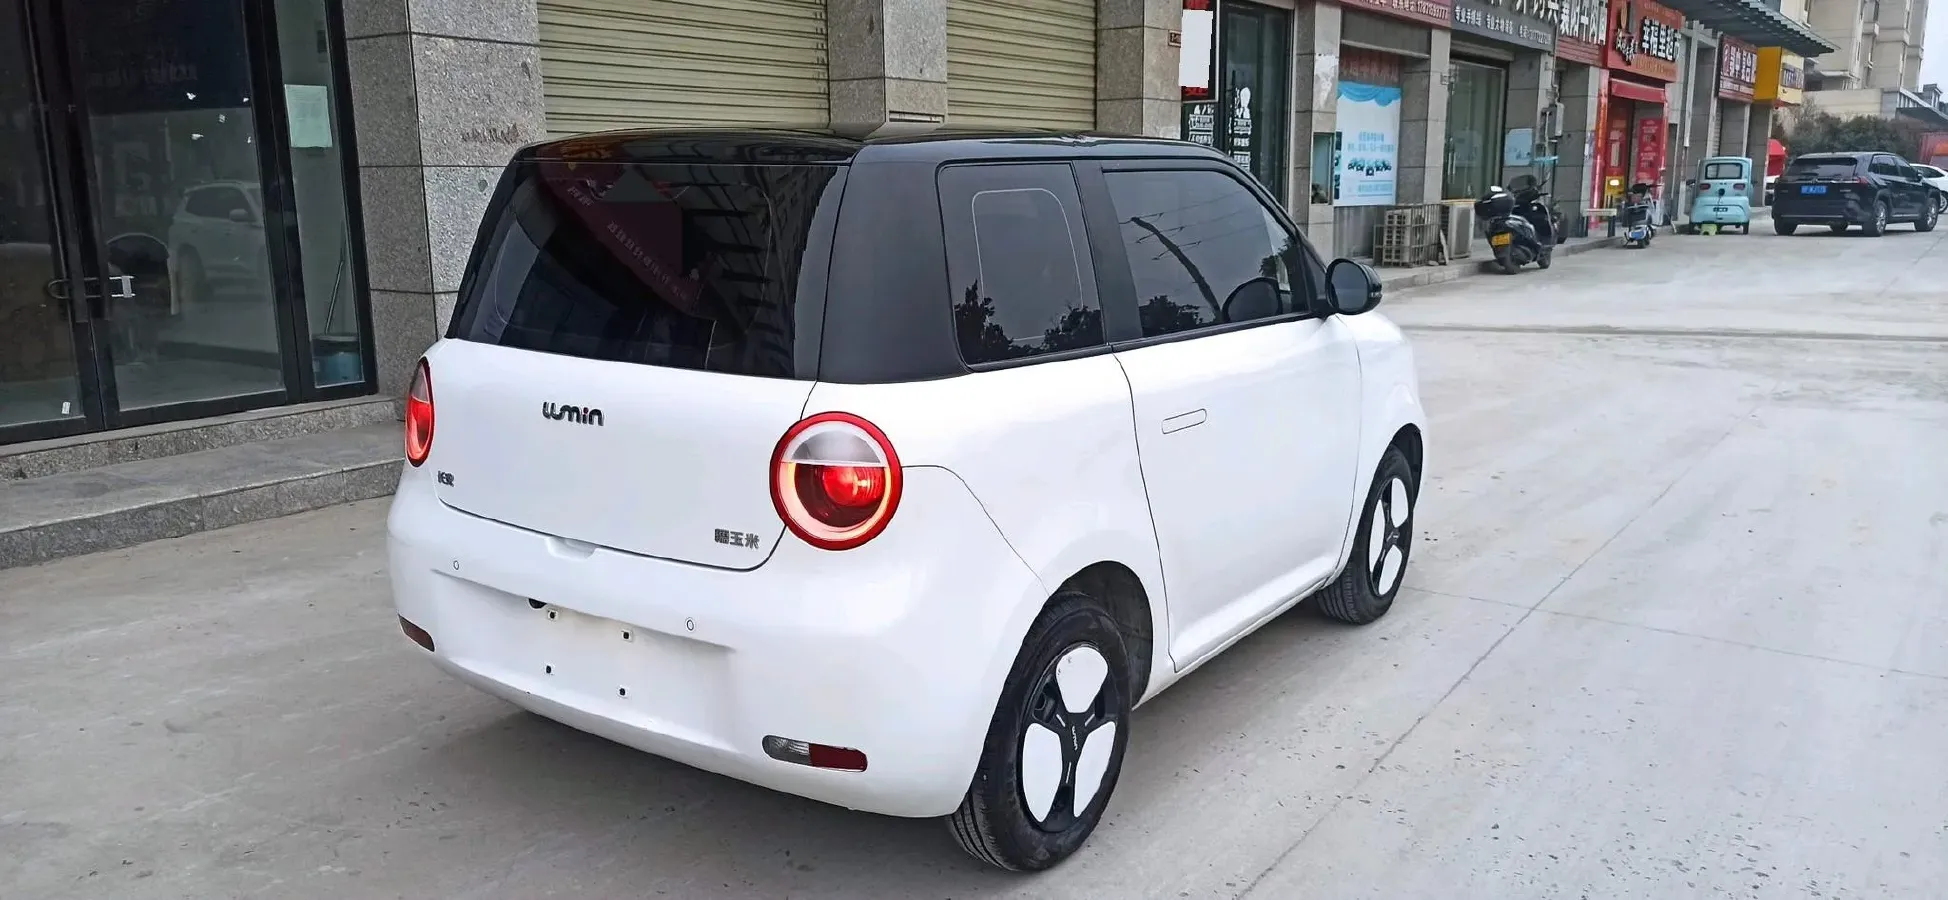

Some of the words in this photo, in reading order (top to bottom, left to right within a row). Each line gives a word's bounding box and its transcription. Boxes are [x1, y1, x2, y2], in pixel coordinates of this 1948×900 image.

[1642, 16, 1681, 61] 幸福里超市
